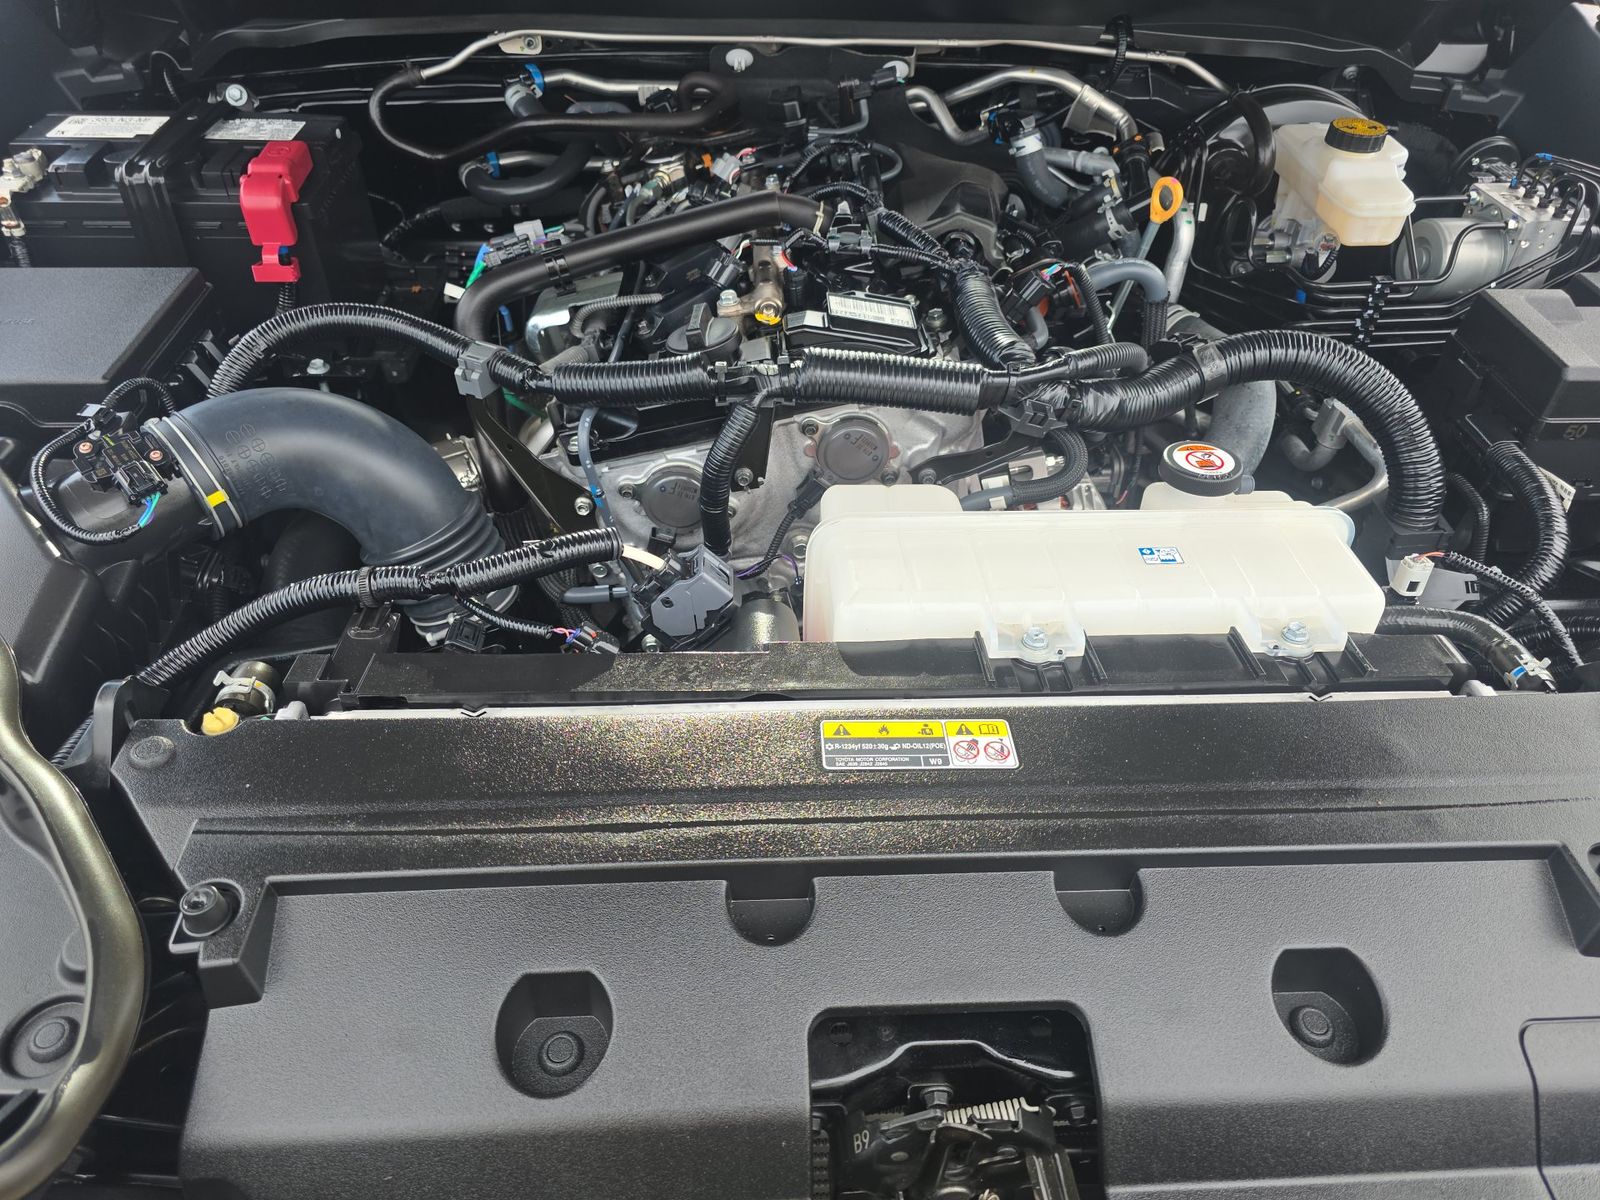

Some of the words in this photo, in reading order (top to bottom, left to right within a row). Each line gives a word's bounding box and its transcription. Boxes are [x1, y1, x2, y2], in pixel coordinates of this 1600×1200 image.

[834, 743, 861, 751] R-1234yf
[928, 757, 943, 765] W9
[853, 1129, 870, 1154] B9
